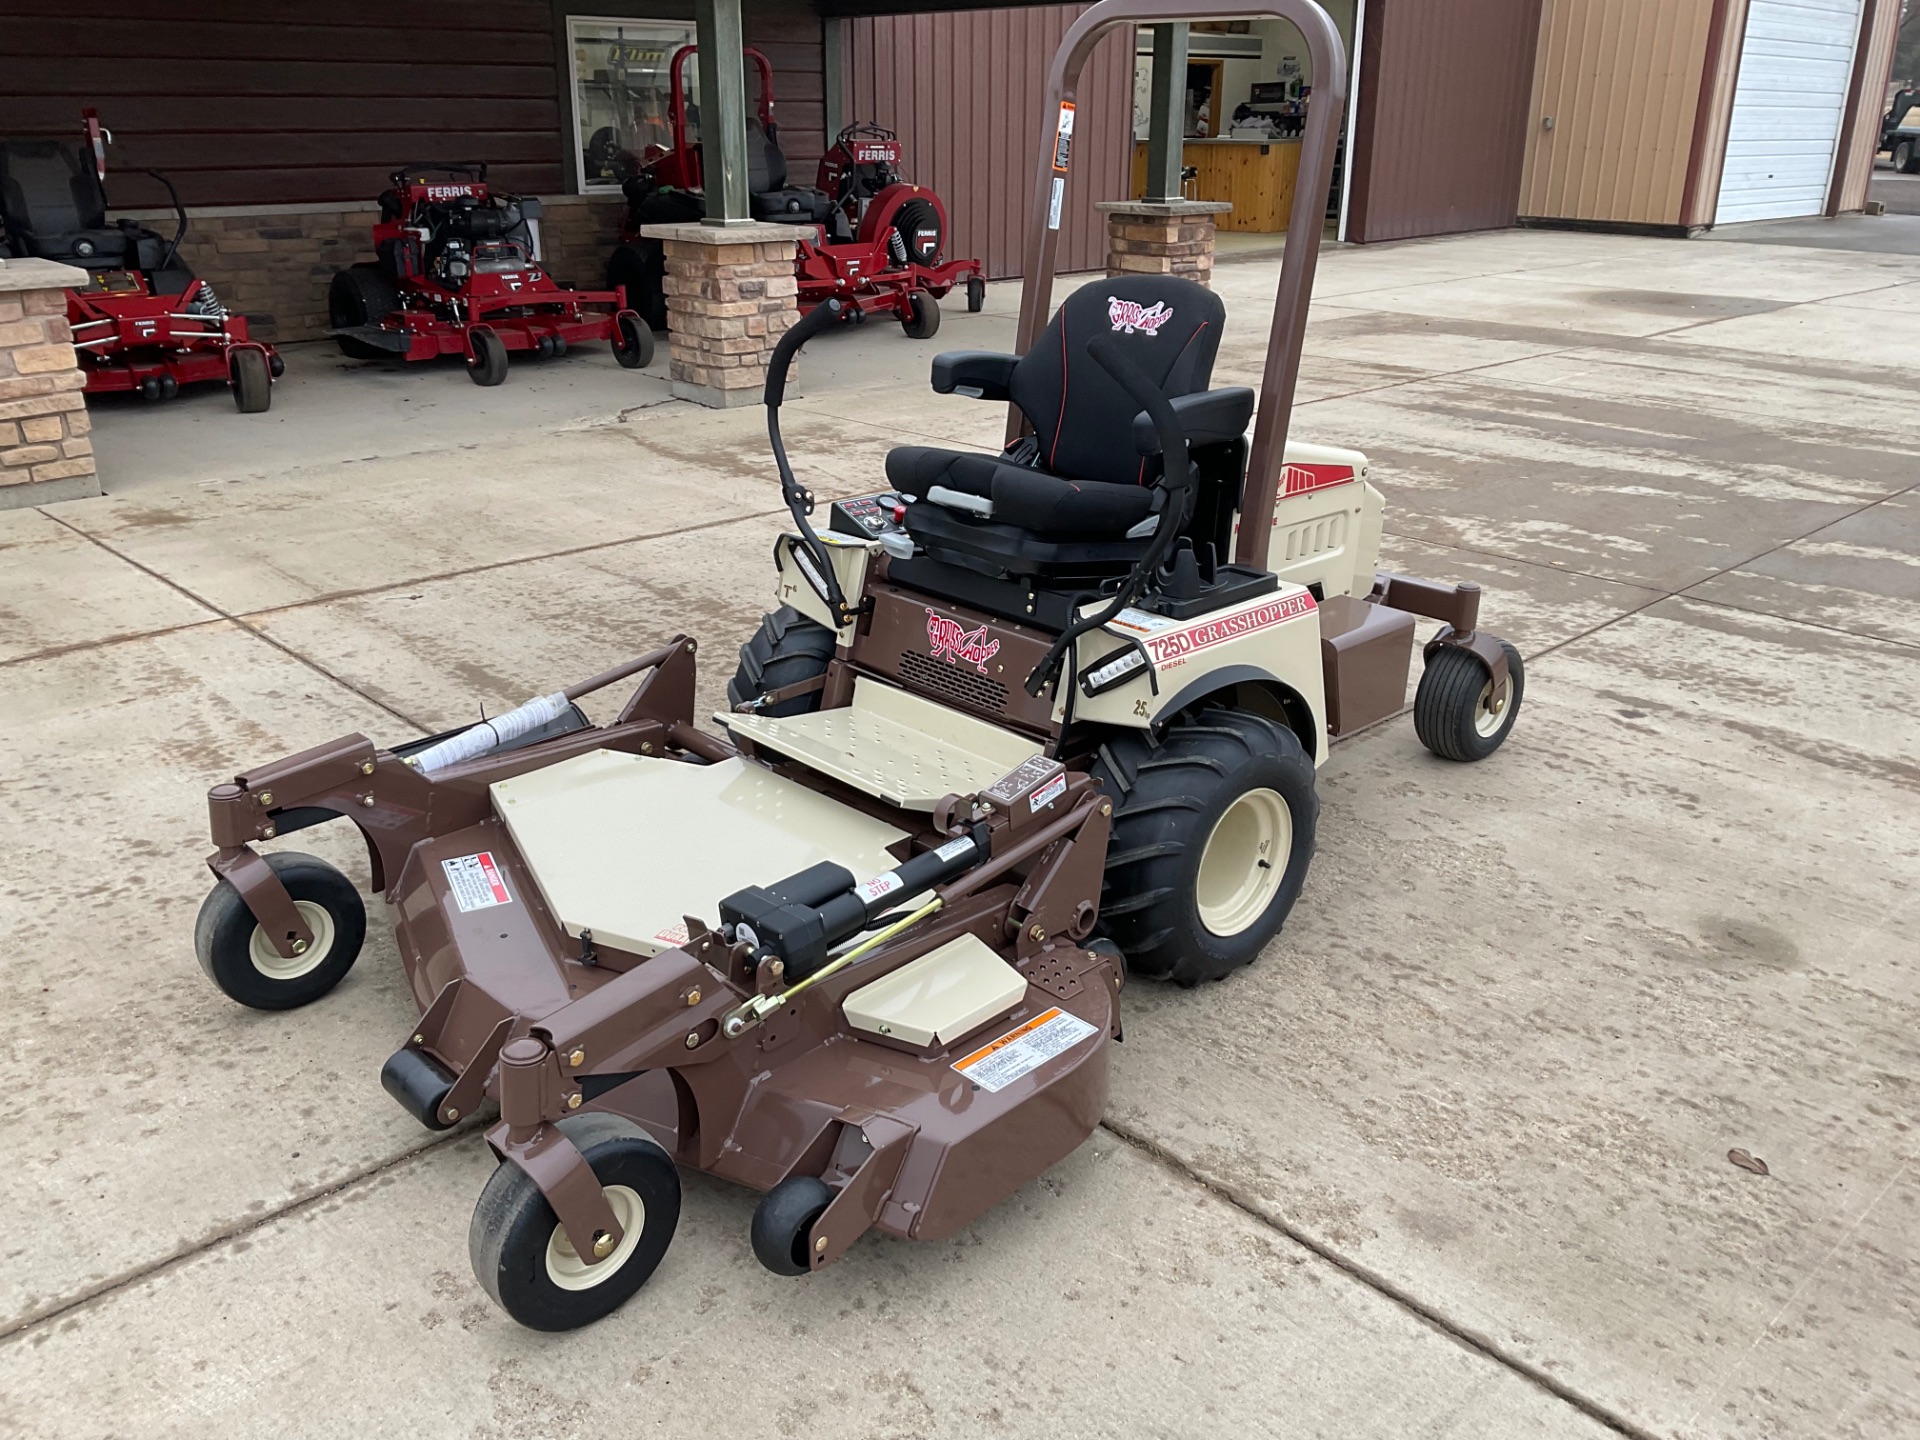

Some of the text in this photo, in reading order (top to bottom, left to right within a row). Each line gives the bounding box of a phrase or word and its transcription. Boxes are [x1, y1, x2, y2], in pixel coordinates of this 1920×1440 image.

[858, 150, 896, 161] FERRIS
[427, 185, 473, 198] FERRIS
[917, 229, 937, 237] FERRIS
[1148, 632, 1191, 661] 725D
[1195, 596, 1308, 645] GRASSHOPPER
[1161, 657, 1187, 671] DIESEL
[866, 878, 881, 888] NO
[869, 880, 891, 897] STEP
[1000, 1025, 1034, 1047] WARNING
